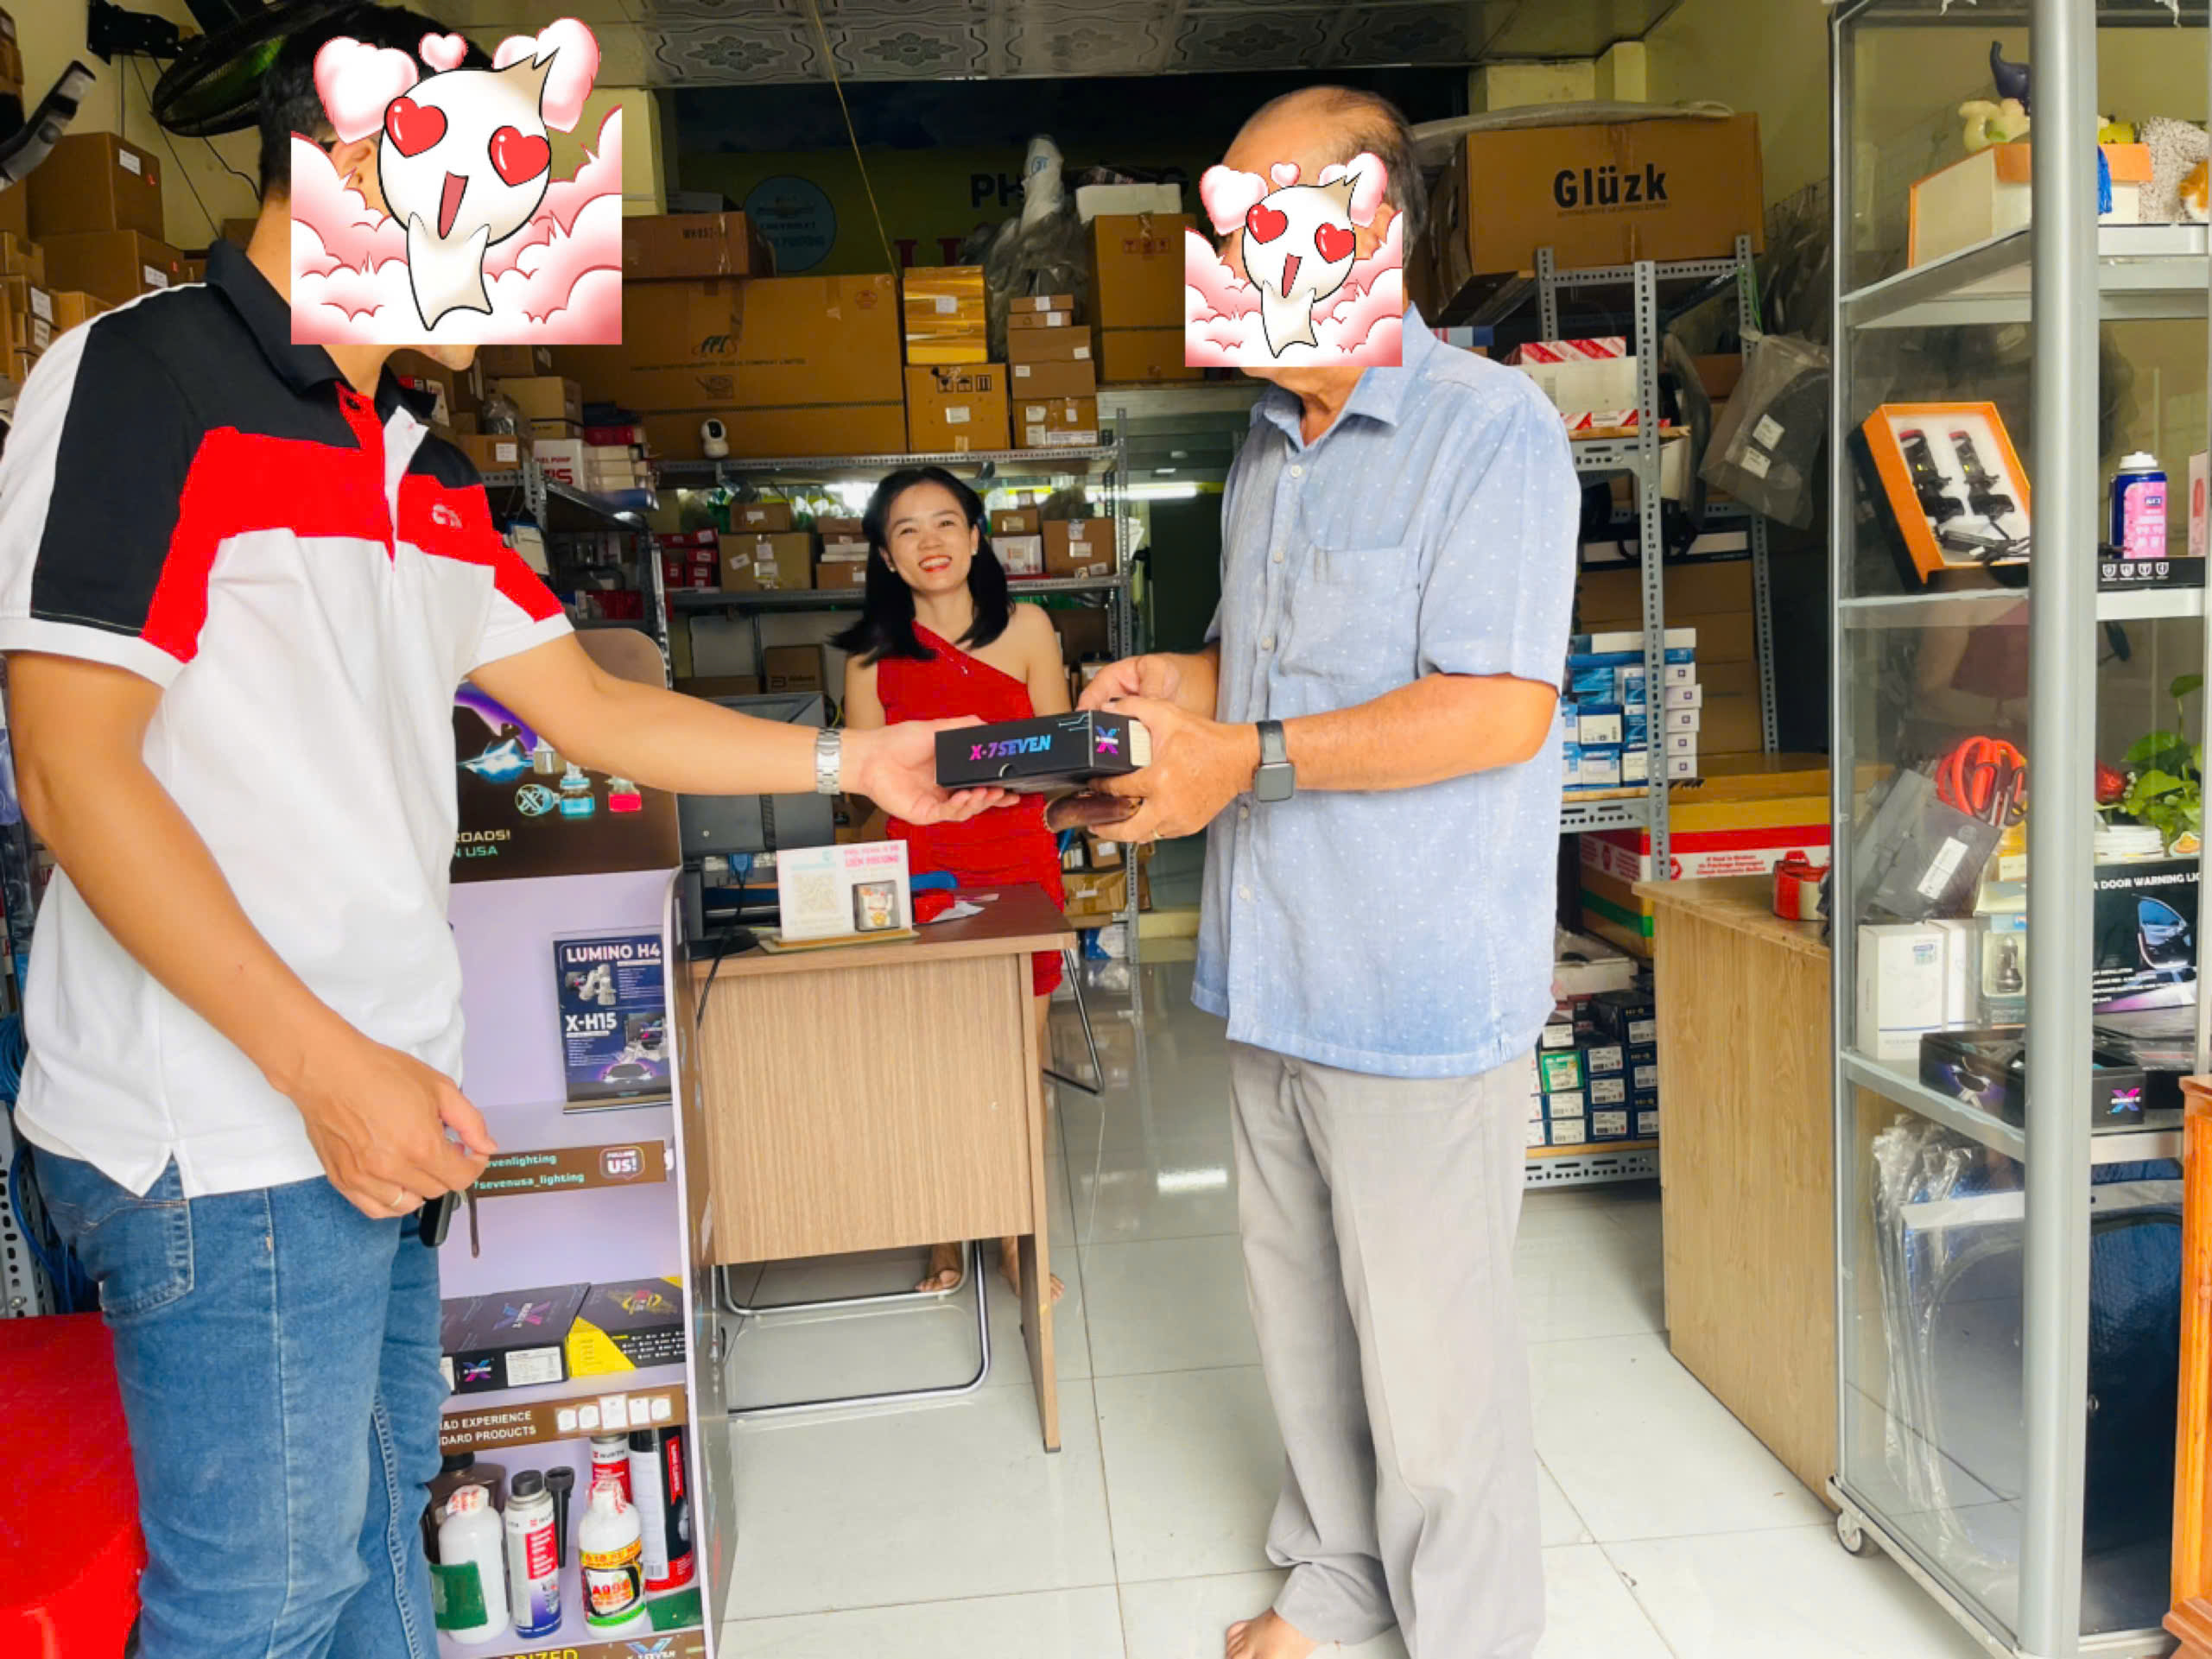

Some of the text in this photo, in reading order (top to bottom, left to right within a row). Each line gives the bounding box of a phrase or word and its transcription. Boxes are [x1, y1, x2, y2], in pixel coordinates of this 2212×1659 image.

[1554, 162, 1668, 208] Glüzk
[969, 734, 1051, 761] X-7SEVEN
[466, 845, 498, 858] USA
[2101, 878, 2133, 890] DOOR
[2133, 874, 2185, 887] WARNING
[566, 942, 662, 963] LUMINO H4
[565, 1011, 618, 1031] X-H15
[607, 1157, 637, 1174] US!
[462, 1410, 532, 1429] EXPERIENCE
[475, 1424, 537, 1442] PRODUCTS
